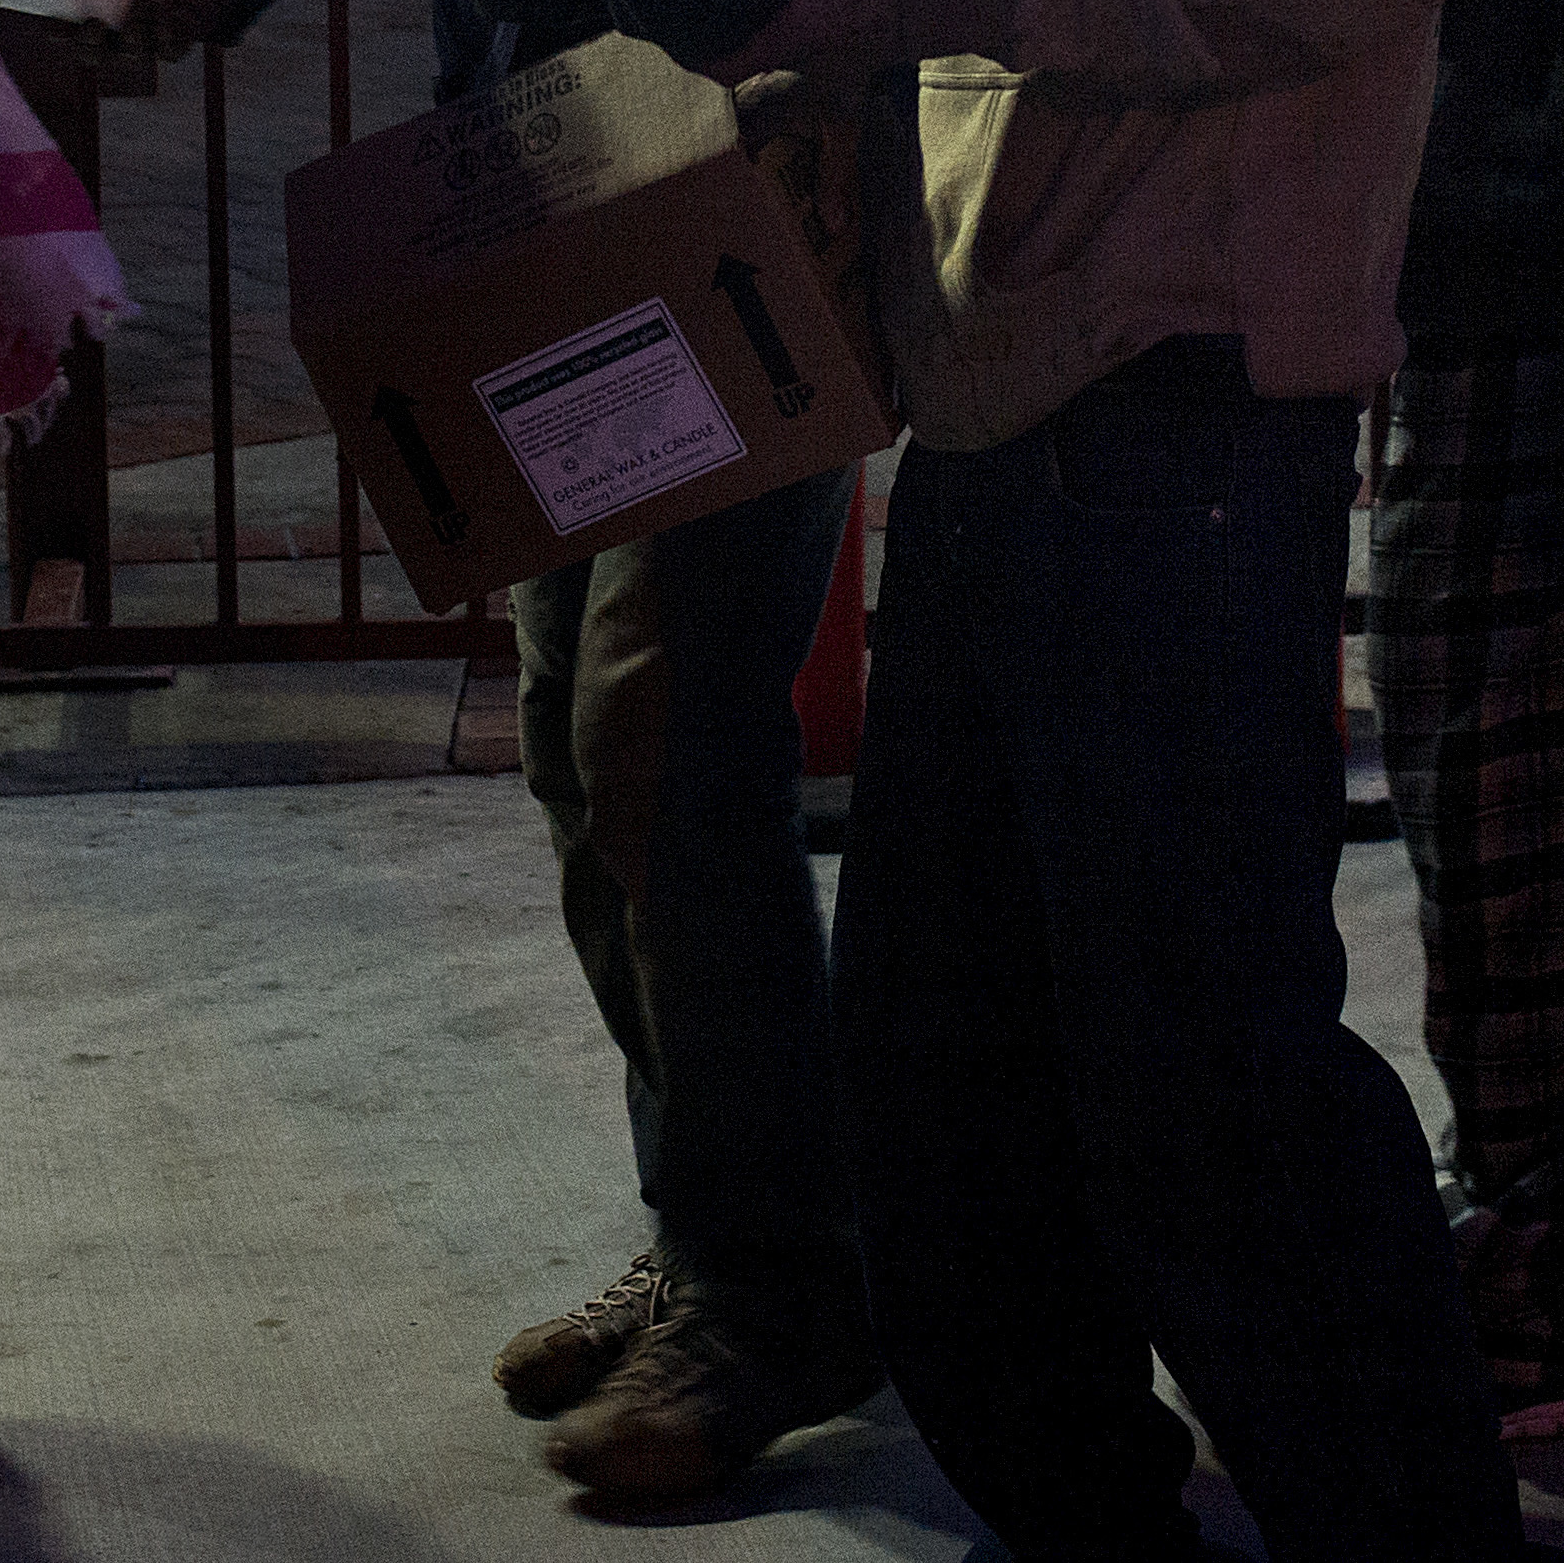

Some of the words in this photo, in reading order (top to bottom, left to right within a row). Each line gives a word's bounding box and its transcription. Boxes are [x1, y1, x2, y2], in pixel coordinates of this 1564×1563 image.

[445, 69, 584, 145] WARNING:
[773, 383, 815, 419] UP
[552, 464, 615, 505] GENERAL
[612, 450, 649, 477] WAX
[660, 420, 720, 456] CANDLE
[571, 487, 612, 515] Caring
[429, 512, 470, 544] UP
